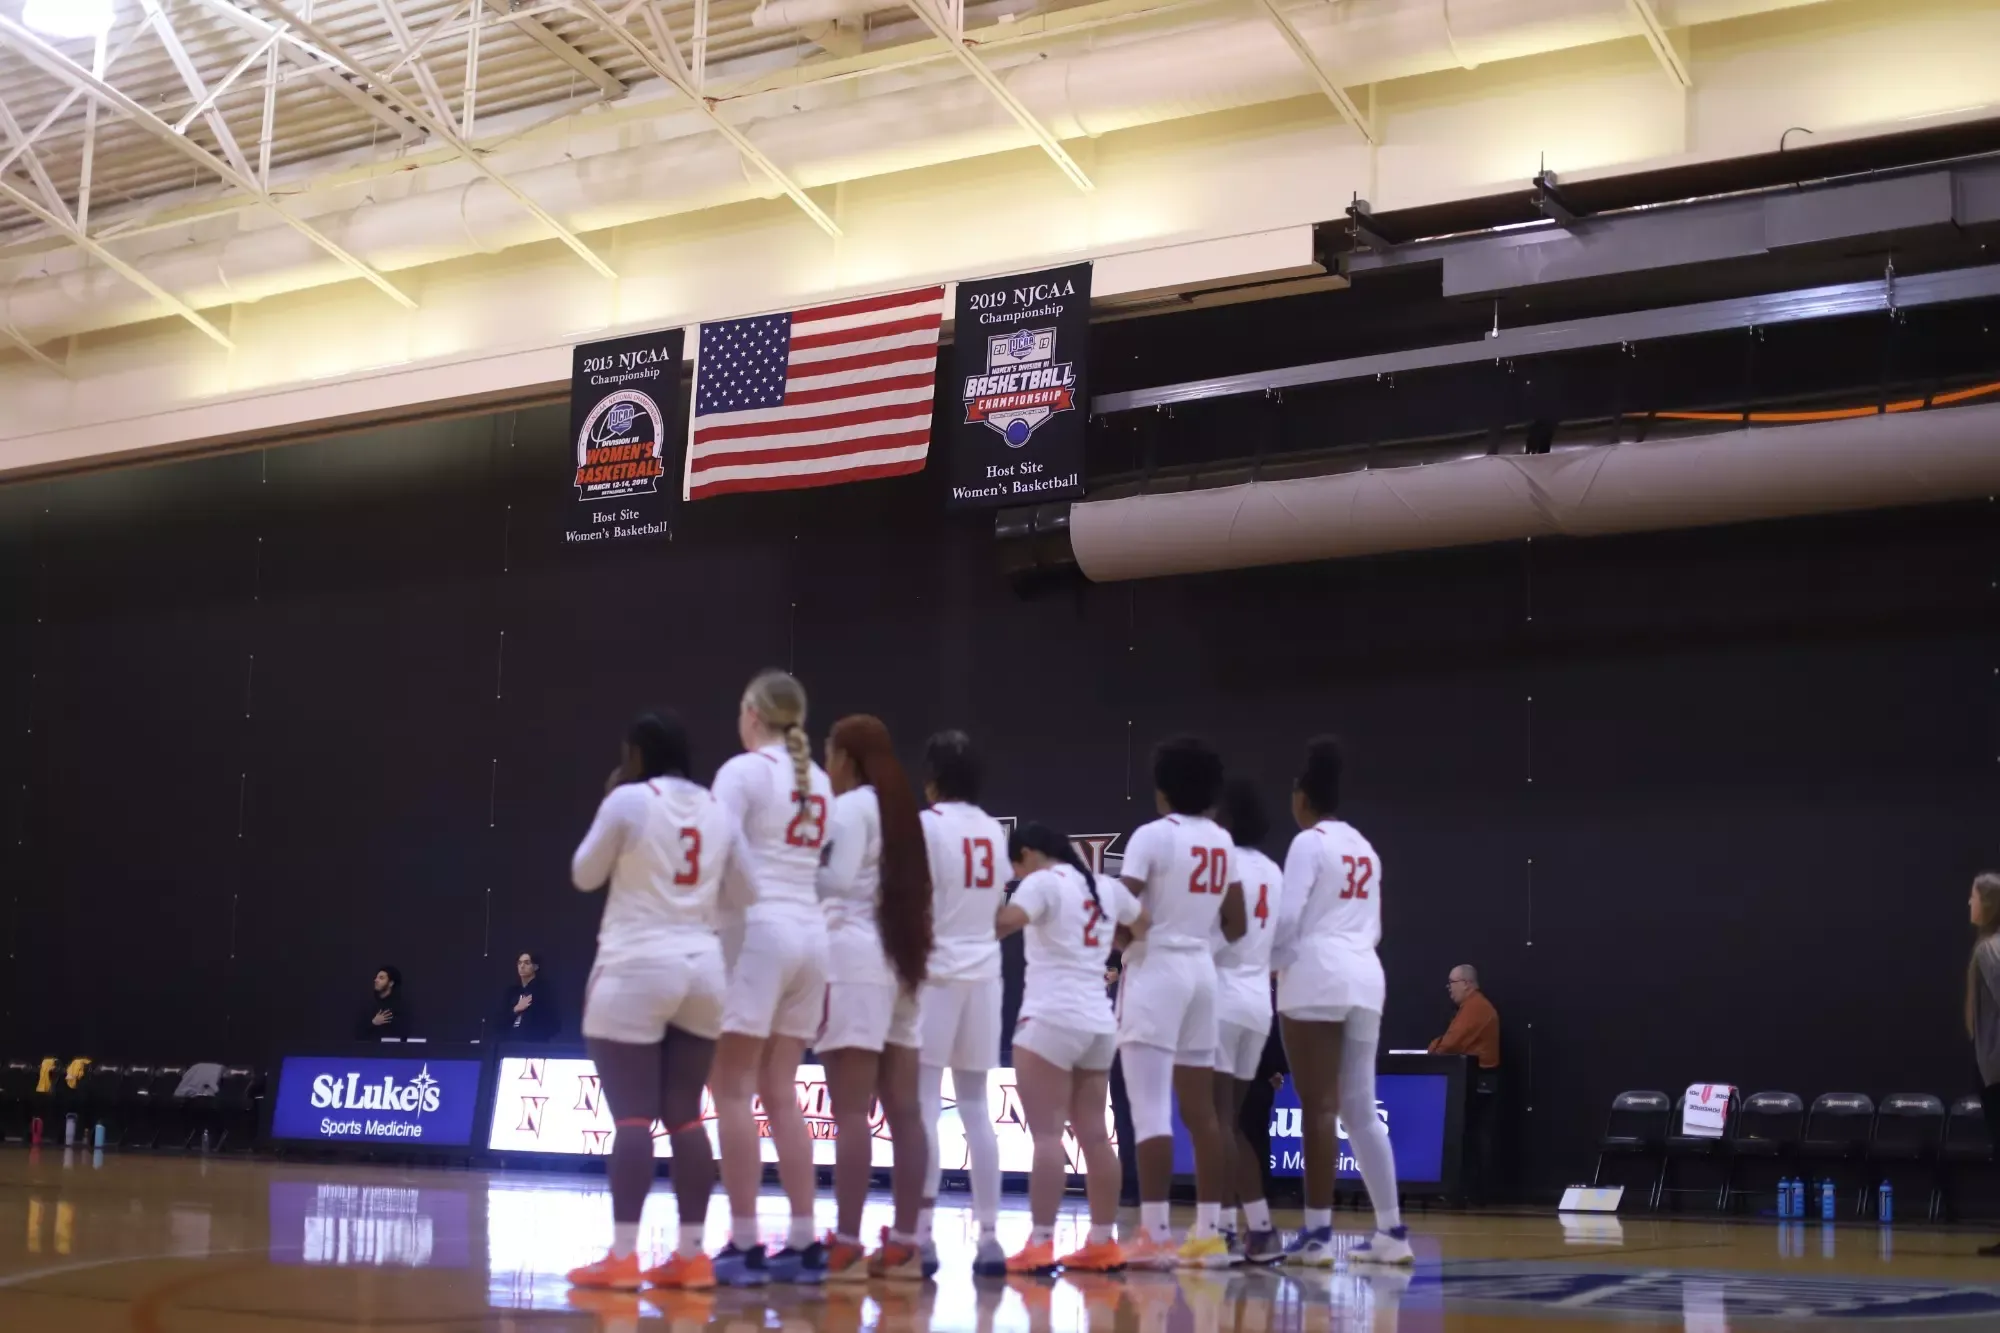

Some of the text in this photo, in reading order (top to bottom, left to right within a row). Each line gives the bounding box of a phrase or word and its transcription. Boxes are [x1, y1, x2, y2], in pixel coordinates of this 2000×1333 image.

[969, 279, 1075, 310] 2019 NJCAA
[979, 304, 1064, 324] Championship
[994, 344, 1007, 355] 20
[1009, 336, 1035, 353] NJCAA
[1039, 338, 1050, 349] 19
[583, 346, 670, 373] 2015 NJCAA
[992, 365, 1018, 374] WOMEN'S
[1018, 362, 1042, 371] DIVISION
[590, 368, 660, 386] Championship
[964, 365, 1074, 398] BASKETBALL
[978, 390, 1063, 410] CHAMPIONSHIP
[609, 409, 635, 427] NJCAA
[587, 441, 655, 465] WOMEN'S
[601, 437, 631, 448] DIVISION
[576, 458, 663, 485] BASKETBALL
[986, 461, 1044, 478] Host Site
[587, 483, 612, 491] MARCH
[631, 478, 648, 486] 2015
[952, 473, 1079, 499] Women's Basketball
[592, 509, 640, 524] Host Site
[565, 521, 668, 542] Women's Basketball
[785, 791, 827, 848] 23
[673, 827, 702, 885] 3
[963, 837, 994, 888] 13
[1188, 846, 1227, 894] 20
[1339, 855, 1373, 899] 32
[1254, 884, 1269, 929] 4
[1083, 899, 1101, 947] 2
[320, 1116, 423, 1137] Sports Medicine
[516, 1096, 550, 1140] N
